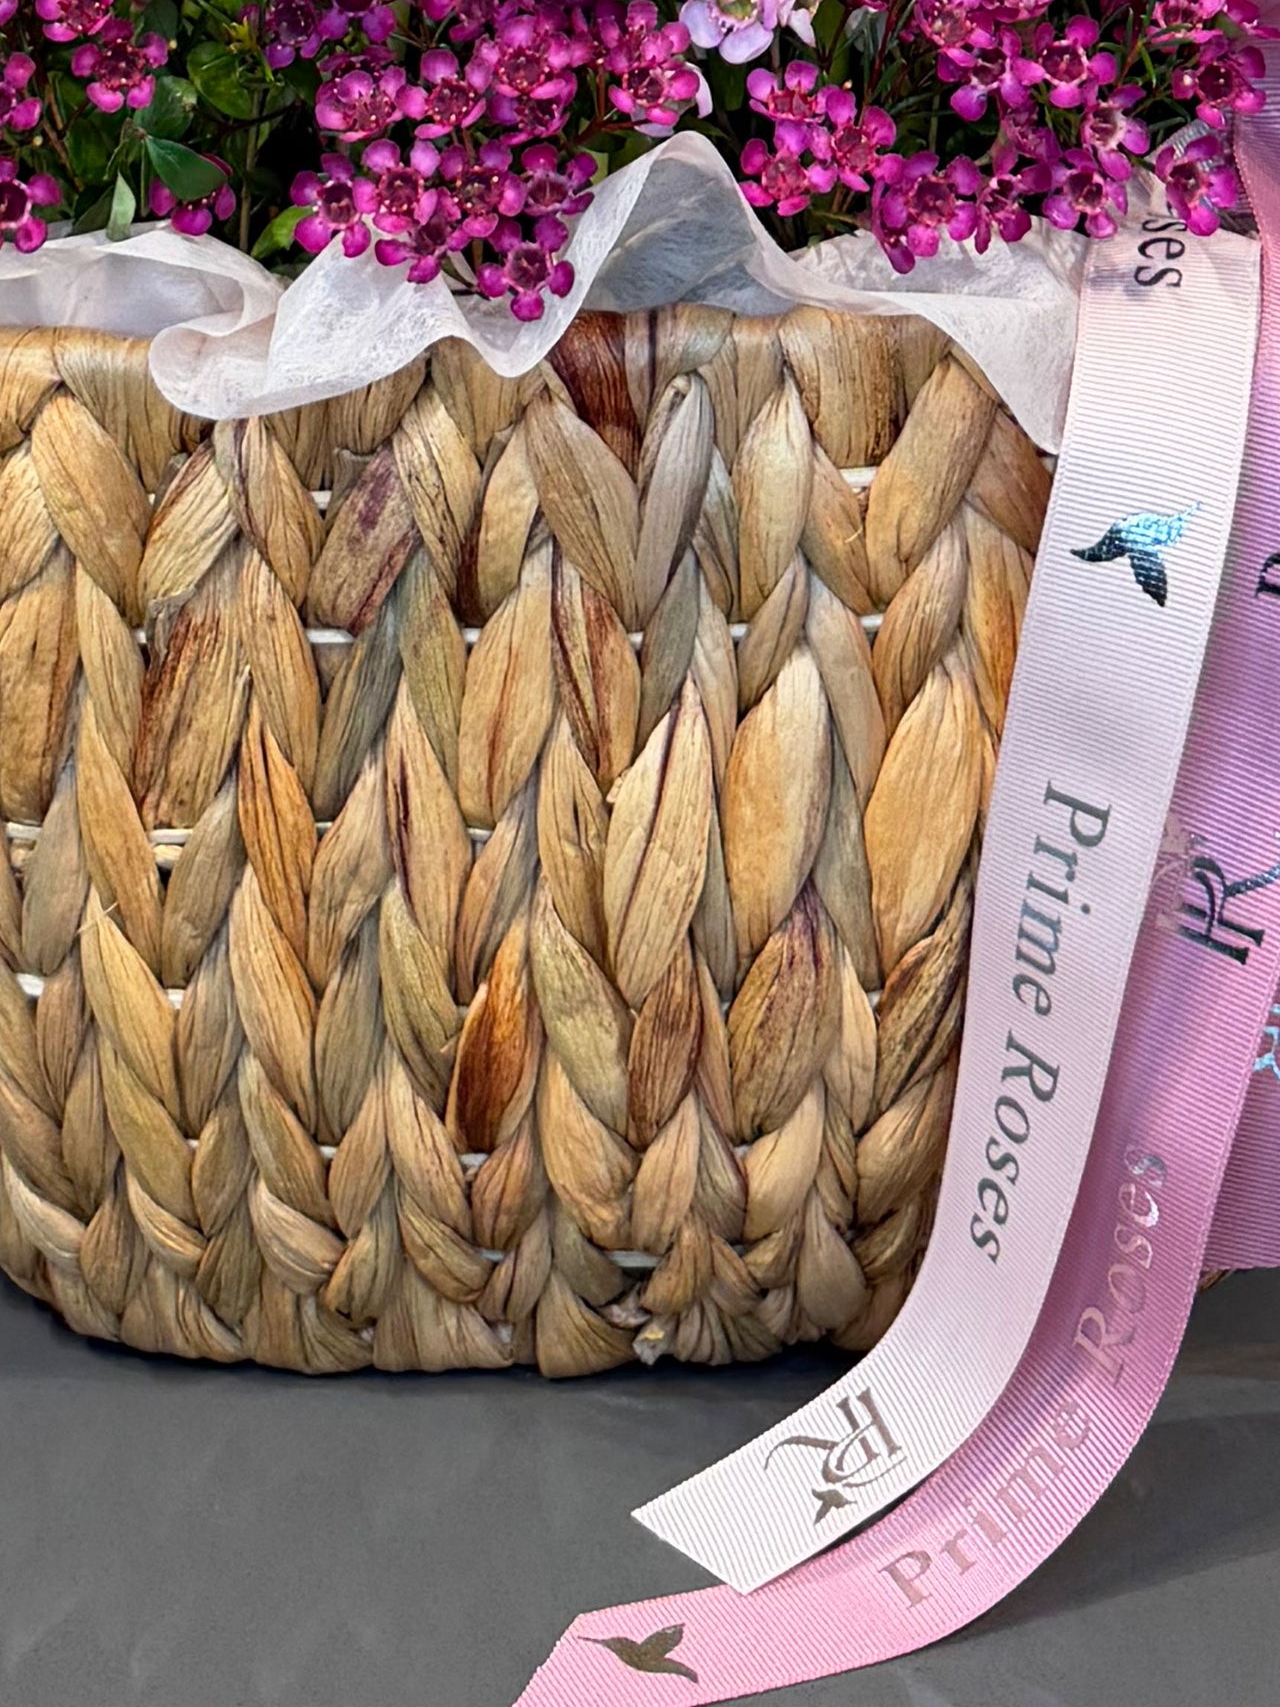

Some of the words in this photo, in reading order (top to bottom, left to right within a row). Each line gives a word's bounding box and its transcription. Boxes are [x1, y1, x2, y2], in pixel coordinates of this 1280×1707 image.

[1135, 215, 1187, 289] ses
[1012, 780, 1111, 1016] Prime
[969, 1030, 1061, 1265] Roses
[878, 1400, 1091, 1610] Prime
[1073, 1143, 1167, 1385] Roses
